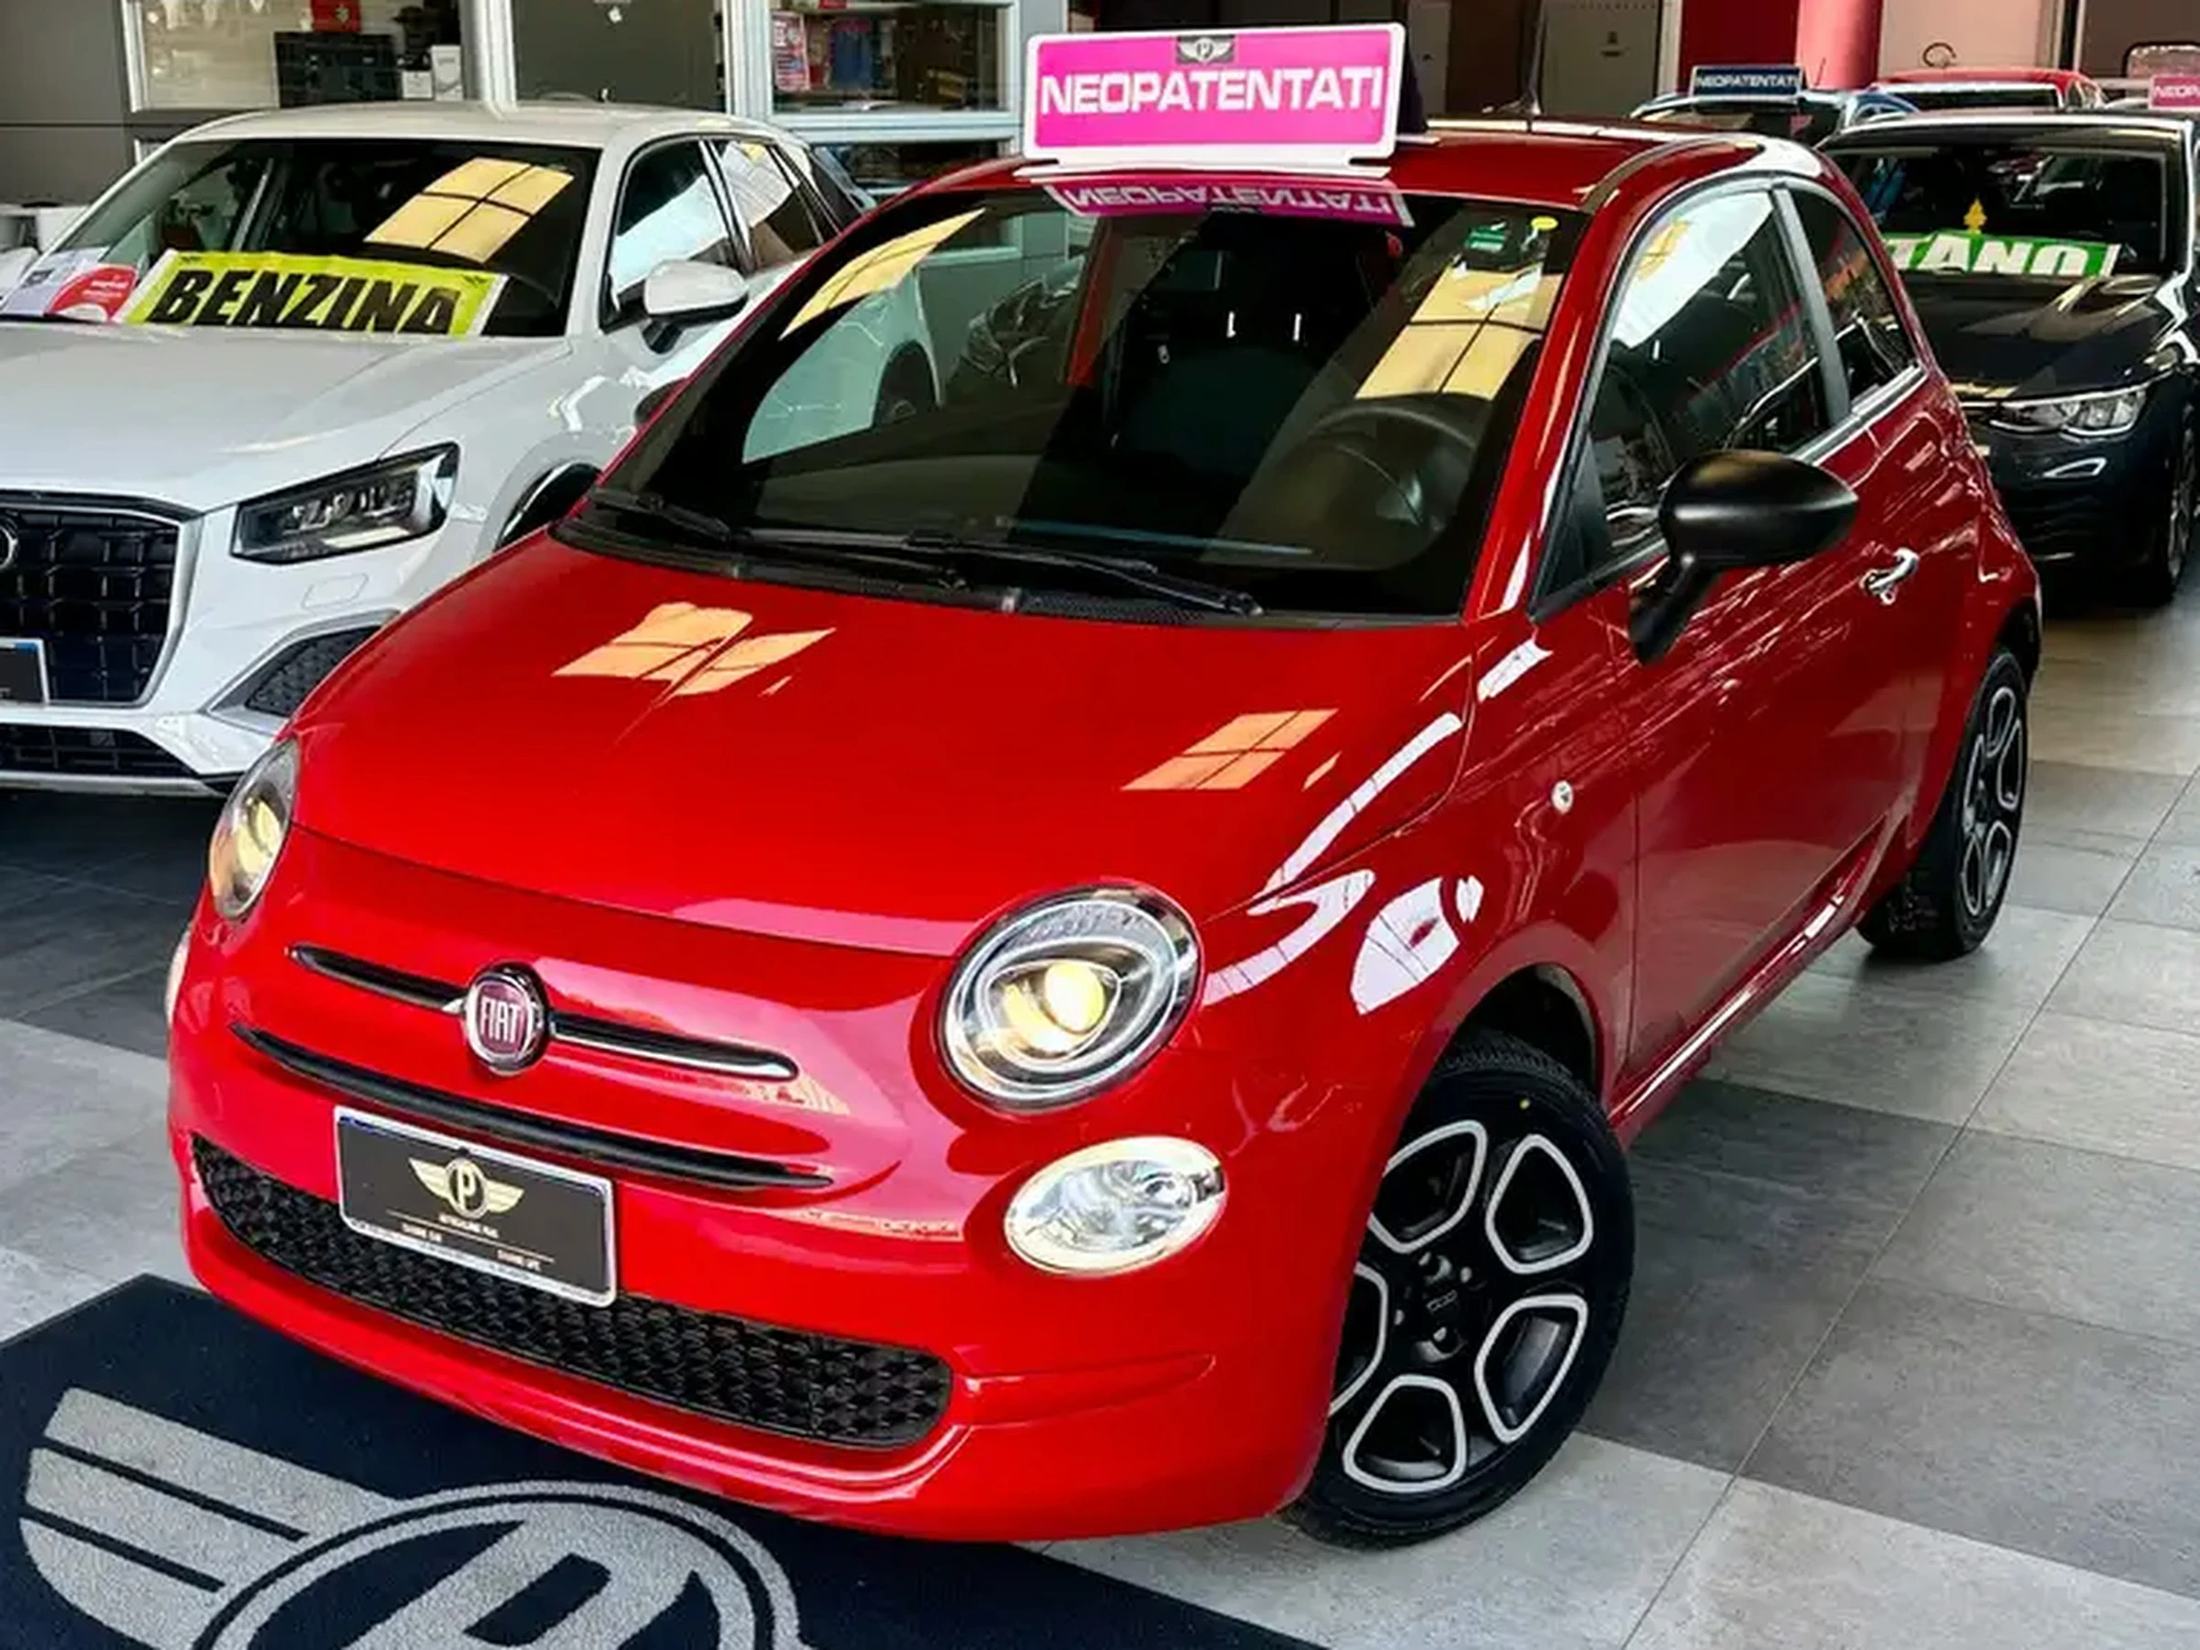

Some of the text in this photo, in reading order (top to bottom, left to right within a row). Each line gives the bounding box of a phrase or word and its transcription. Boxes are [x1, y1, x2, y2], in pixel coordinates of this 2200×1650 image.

[1041, 66, 1384, 116] NEOPATENTATI
[145, 270, 462, 334] BENZINA
[481, 994, 522, 1043] FIAT
